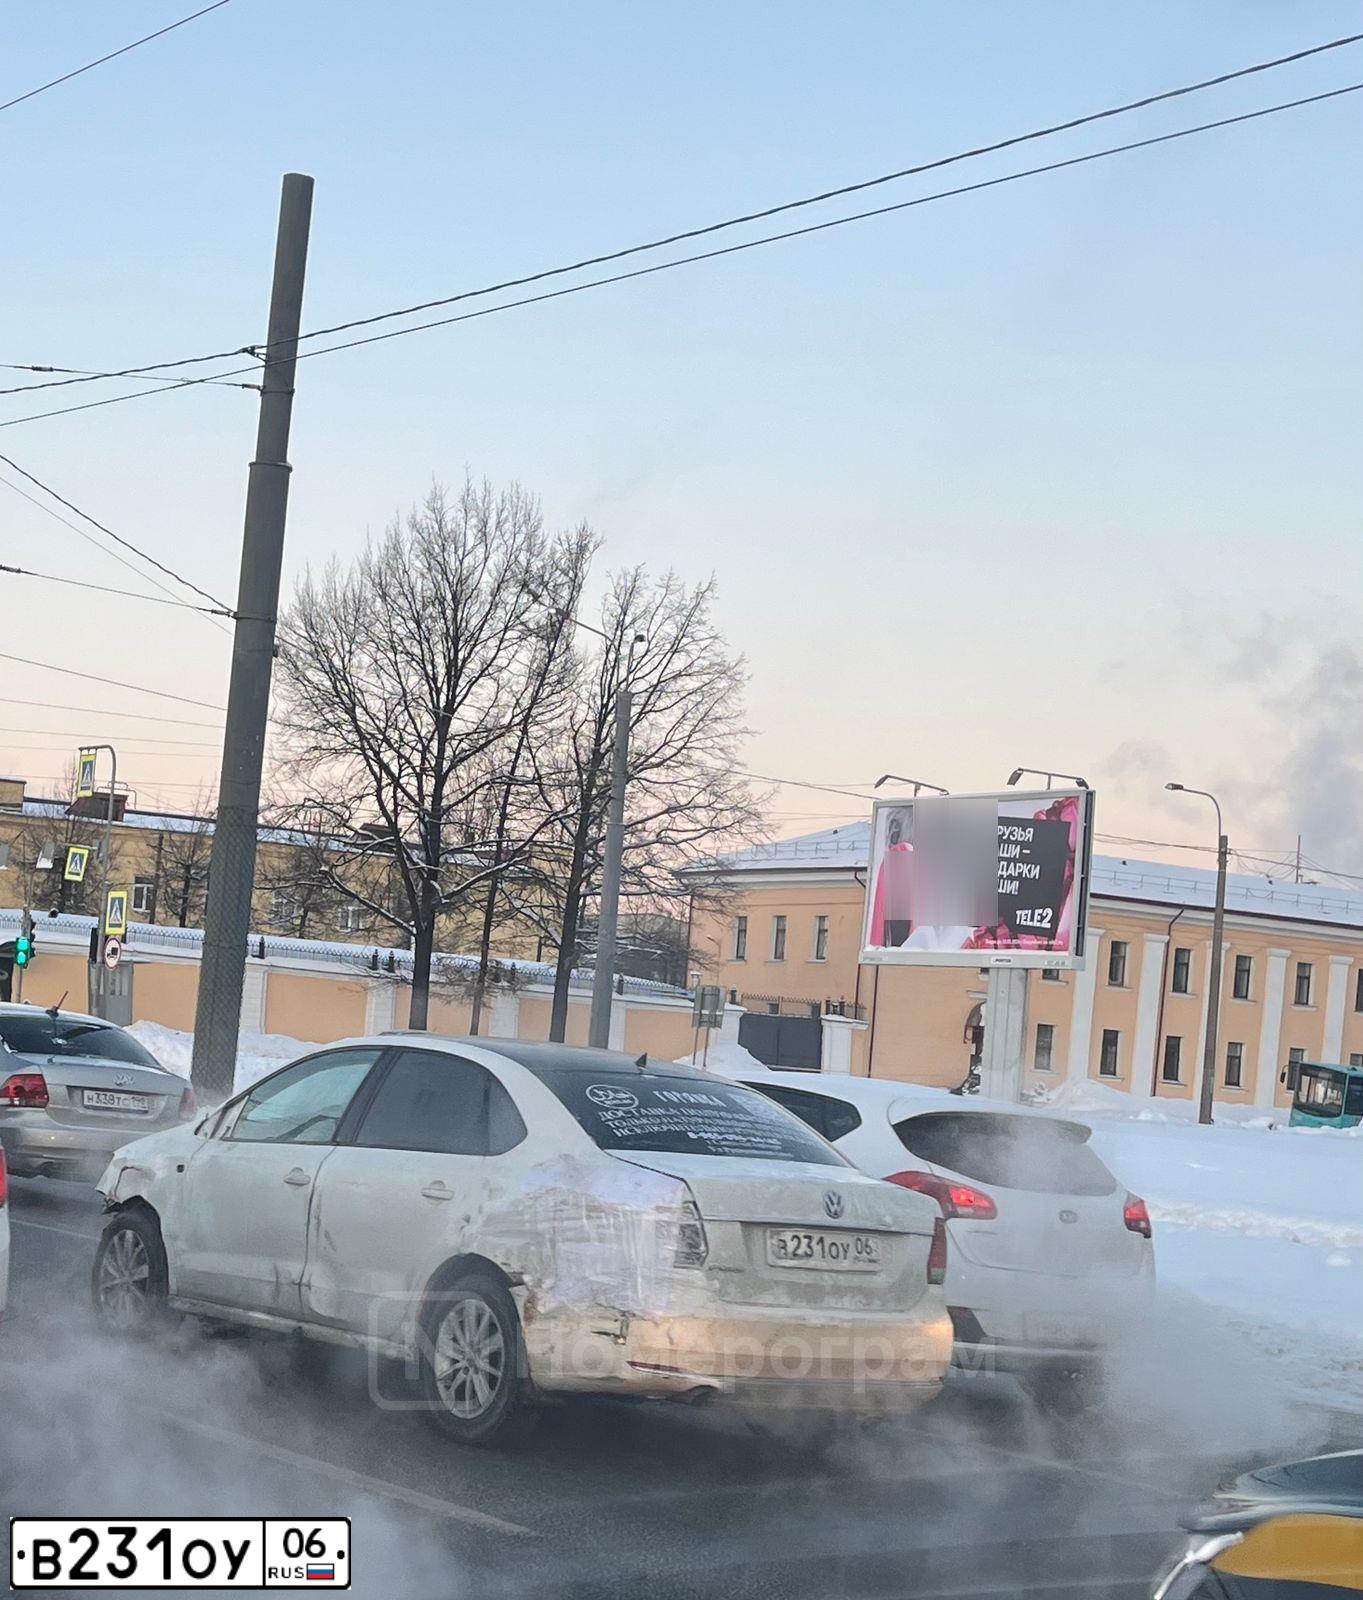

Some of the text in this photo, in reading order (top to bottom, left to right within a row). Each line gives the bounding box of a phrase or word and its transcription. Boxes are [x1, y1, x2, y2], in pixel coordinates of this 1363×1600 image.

[998, 825, 1034, 843] РУЗЬЯ
[998, 843, 1020, 859] ШИ
[998, 861, 1040, 880] ДАРКИ
[998, 879, 1020, 895] ШИ!
[1015, 907, 1054, 929] TELE2
[855, 1237, 873, 1255] 06
